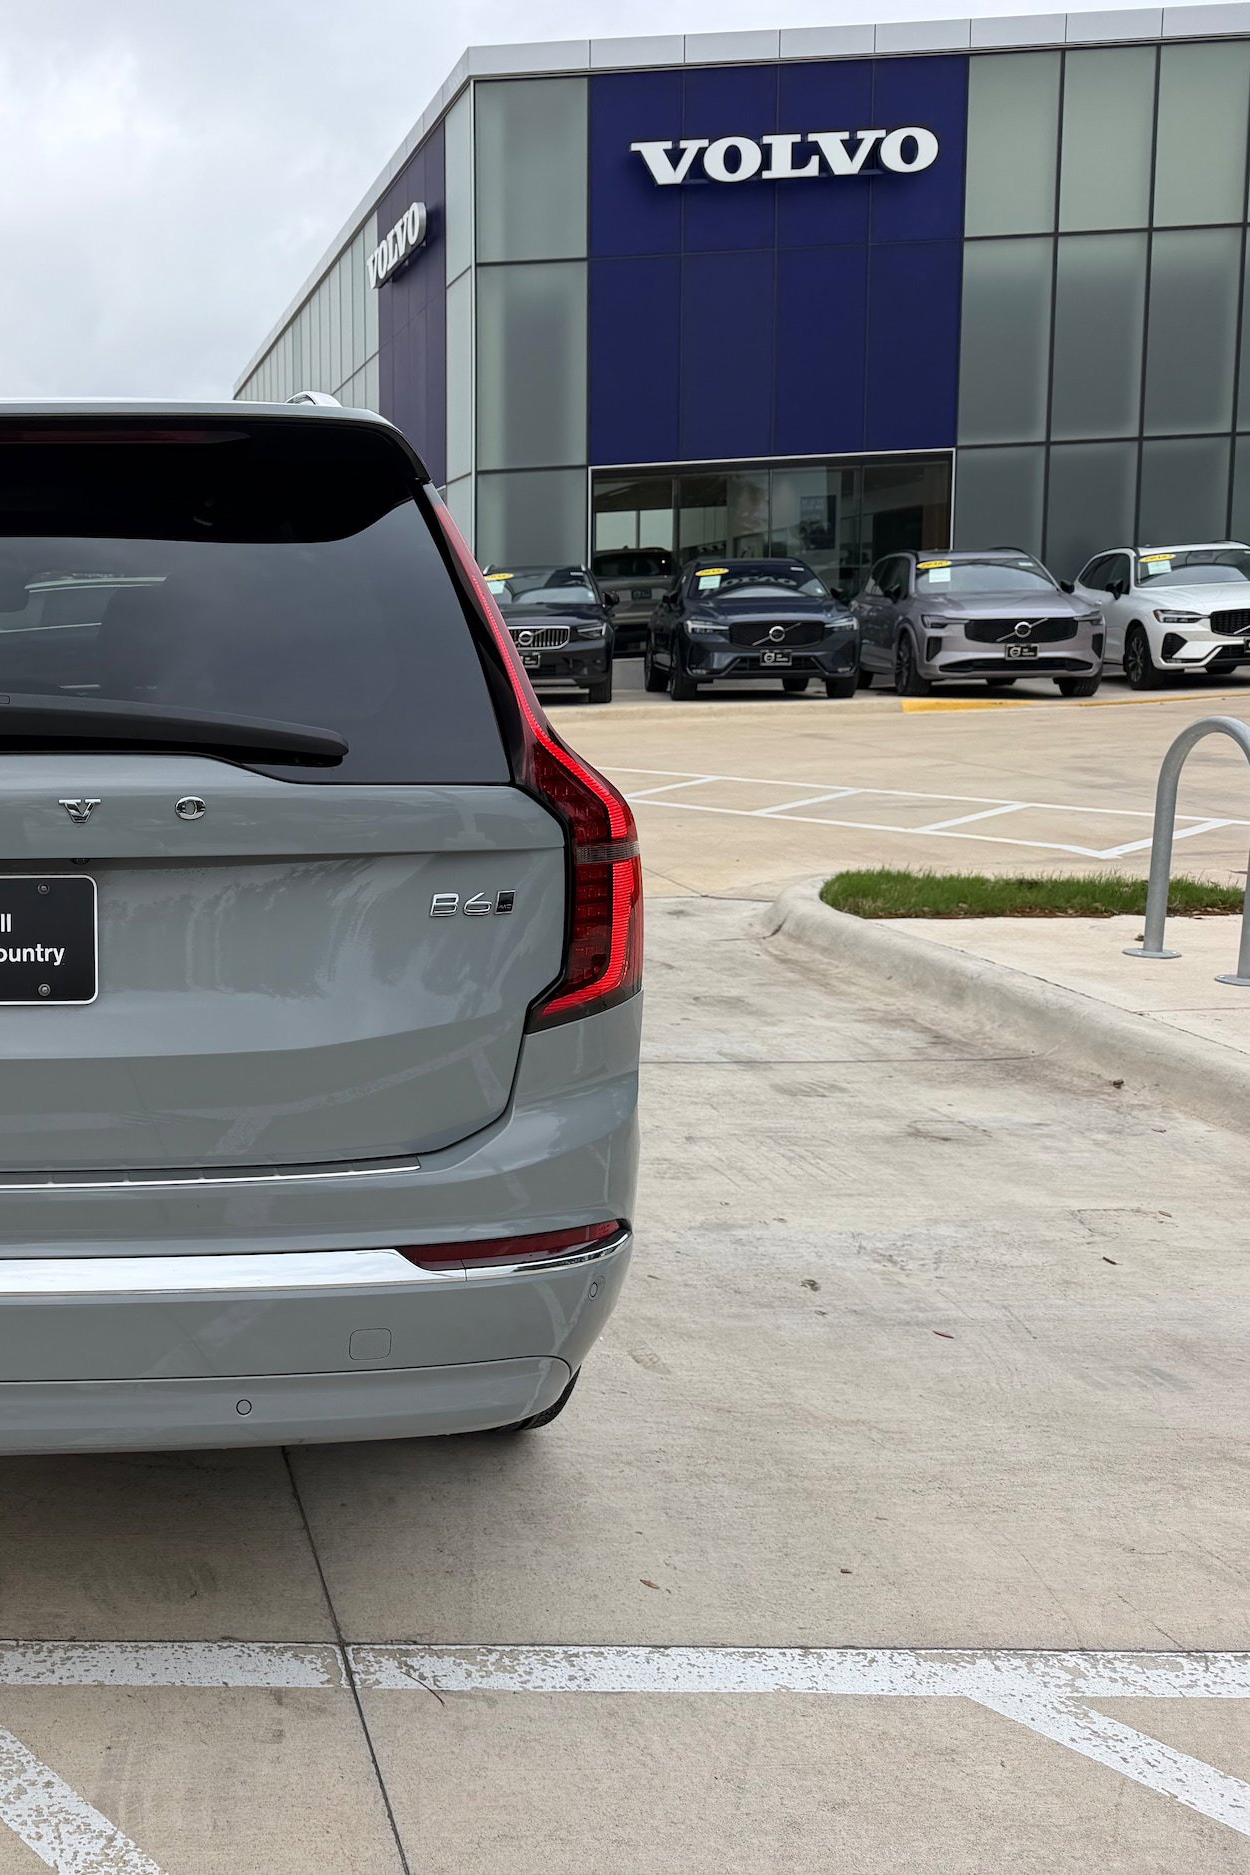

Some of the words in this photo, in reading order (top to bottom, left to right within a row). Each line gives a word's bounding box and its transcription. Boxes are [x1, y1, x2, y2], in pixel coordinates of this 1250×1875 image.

[629, 125, 939, 186] VOLVO
[365, 202, 427, 289] VOLVO
[429, 891, 493, 917] B6
